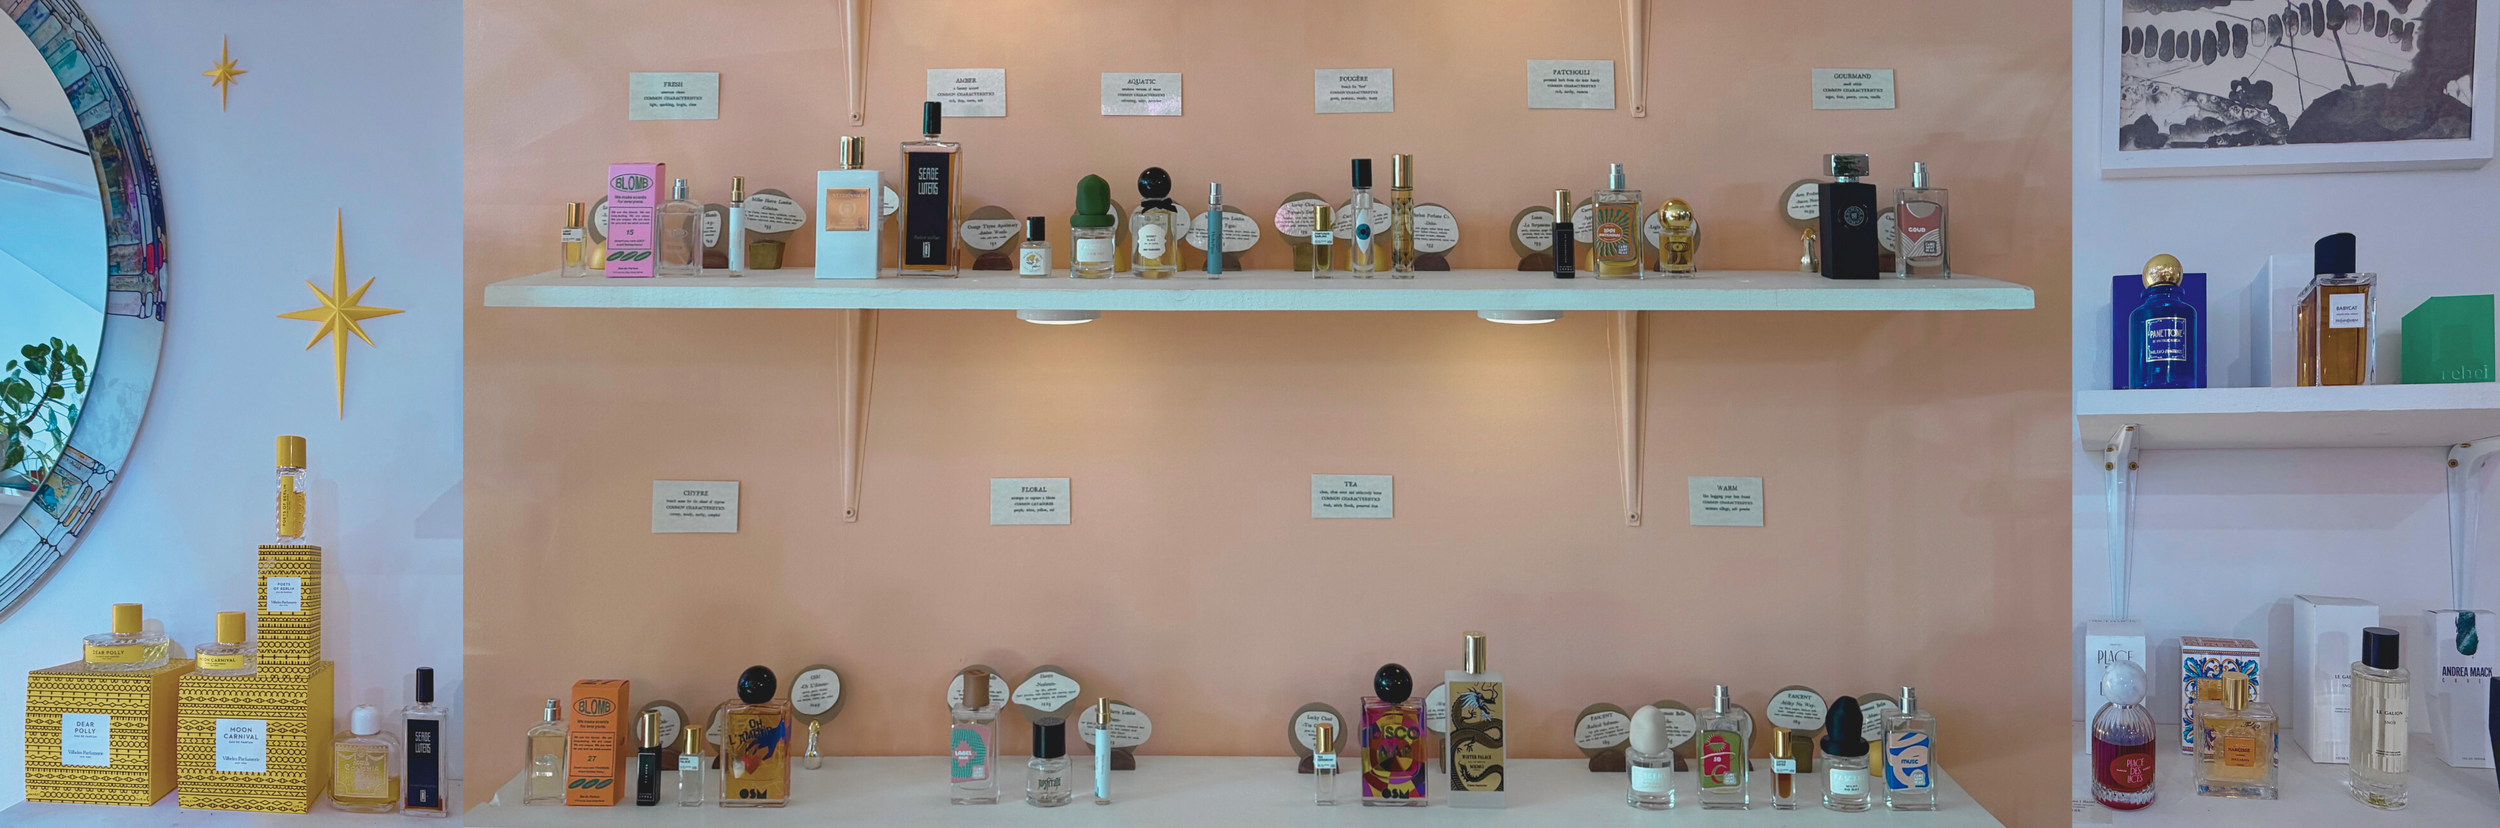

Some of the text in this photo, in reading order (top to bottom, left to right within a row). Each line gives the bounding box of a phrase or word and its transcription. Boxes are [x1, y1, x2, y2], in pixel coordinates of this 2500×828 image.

[615, 176, 648, 190] BLOMB
[918, 182, 938, 195] LUTENS
[2150, 328, 2183, 338] PANETTONE
[2098, 650, 2133, 665] PLACE
[2442, 666, 2492, 677] ANDREA MAACK
[579, 699, 610, 714] BLOMB
[1590, 713, 1614, 721] FASCENT
[748, 718, 762, 729] OH
[728, 727, 772, 745] L'AMOUR
[1372, 726, 1420, 740] DISCO
[415, 743, 431, 753] LUTENS
[1379, 745, 1411, 757] NAP
[2127, 758, 2145, 767] PLACE
[2130, 766, 2141, 775] DES
[2127, 774, 2143, 783] LICES
[739, 789, 767, 799] OSM
[1382, 788, 1410, 799] OSM
